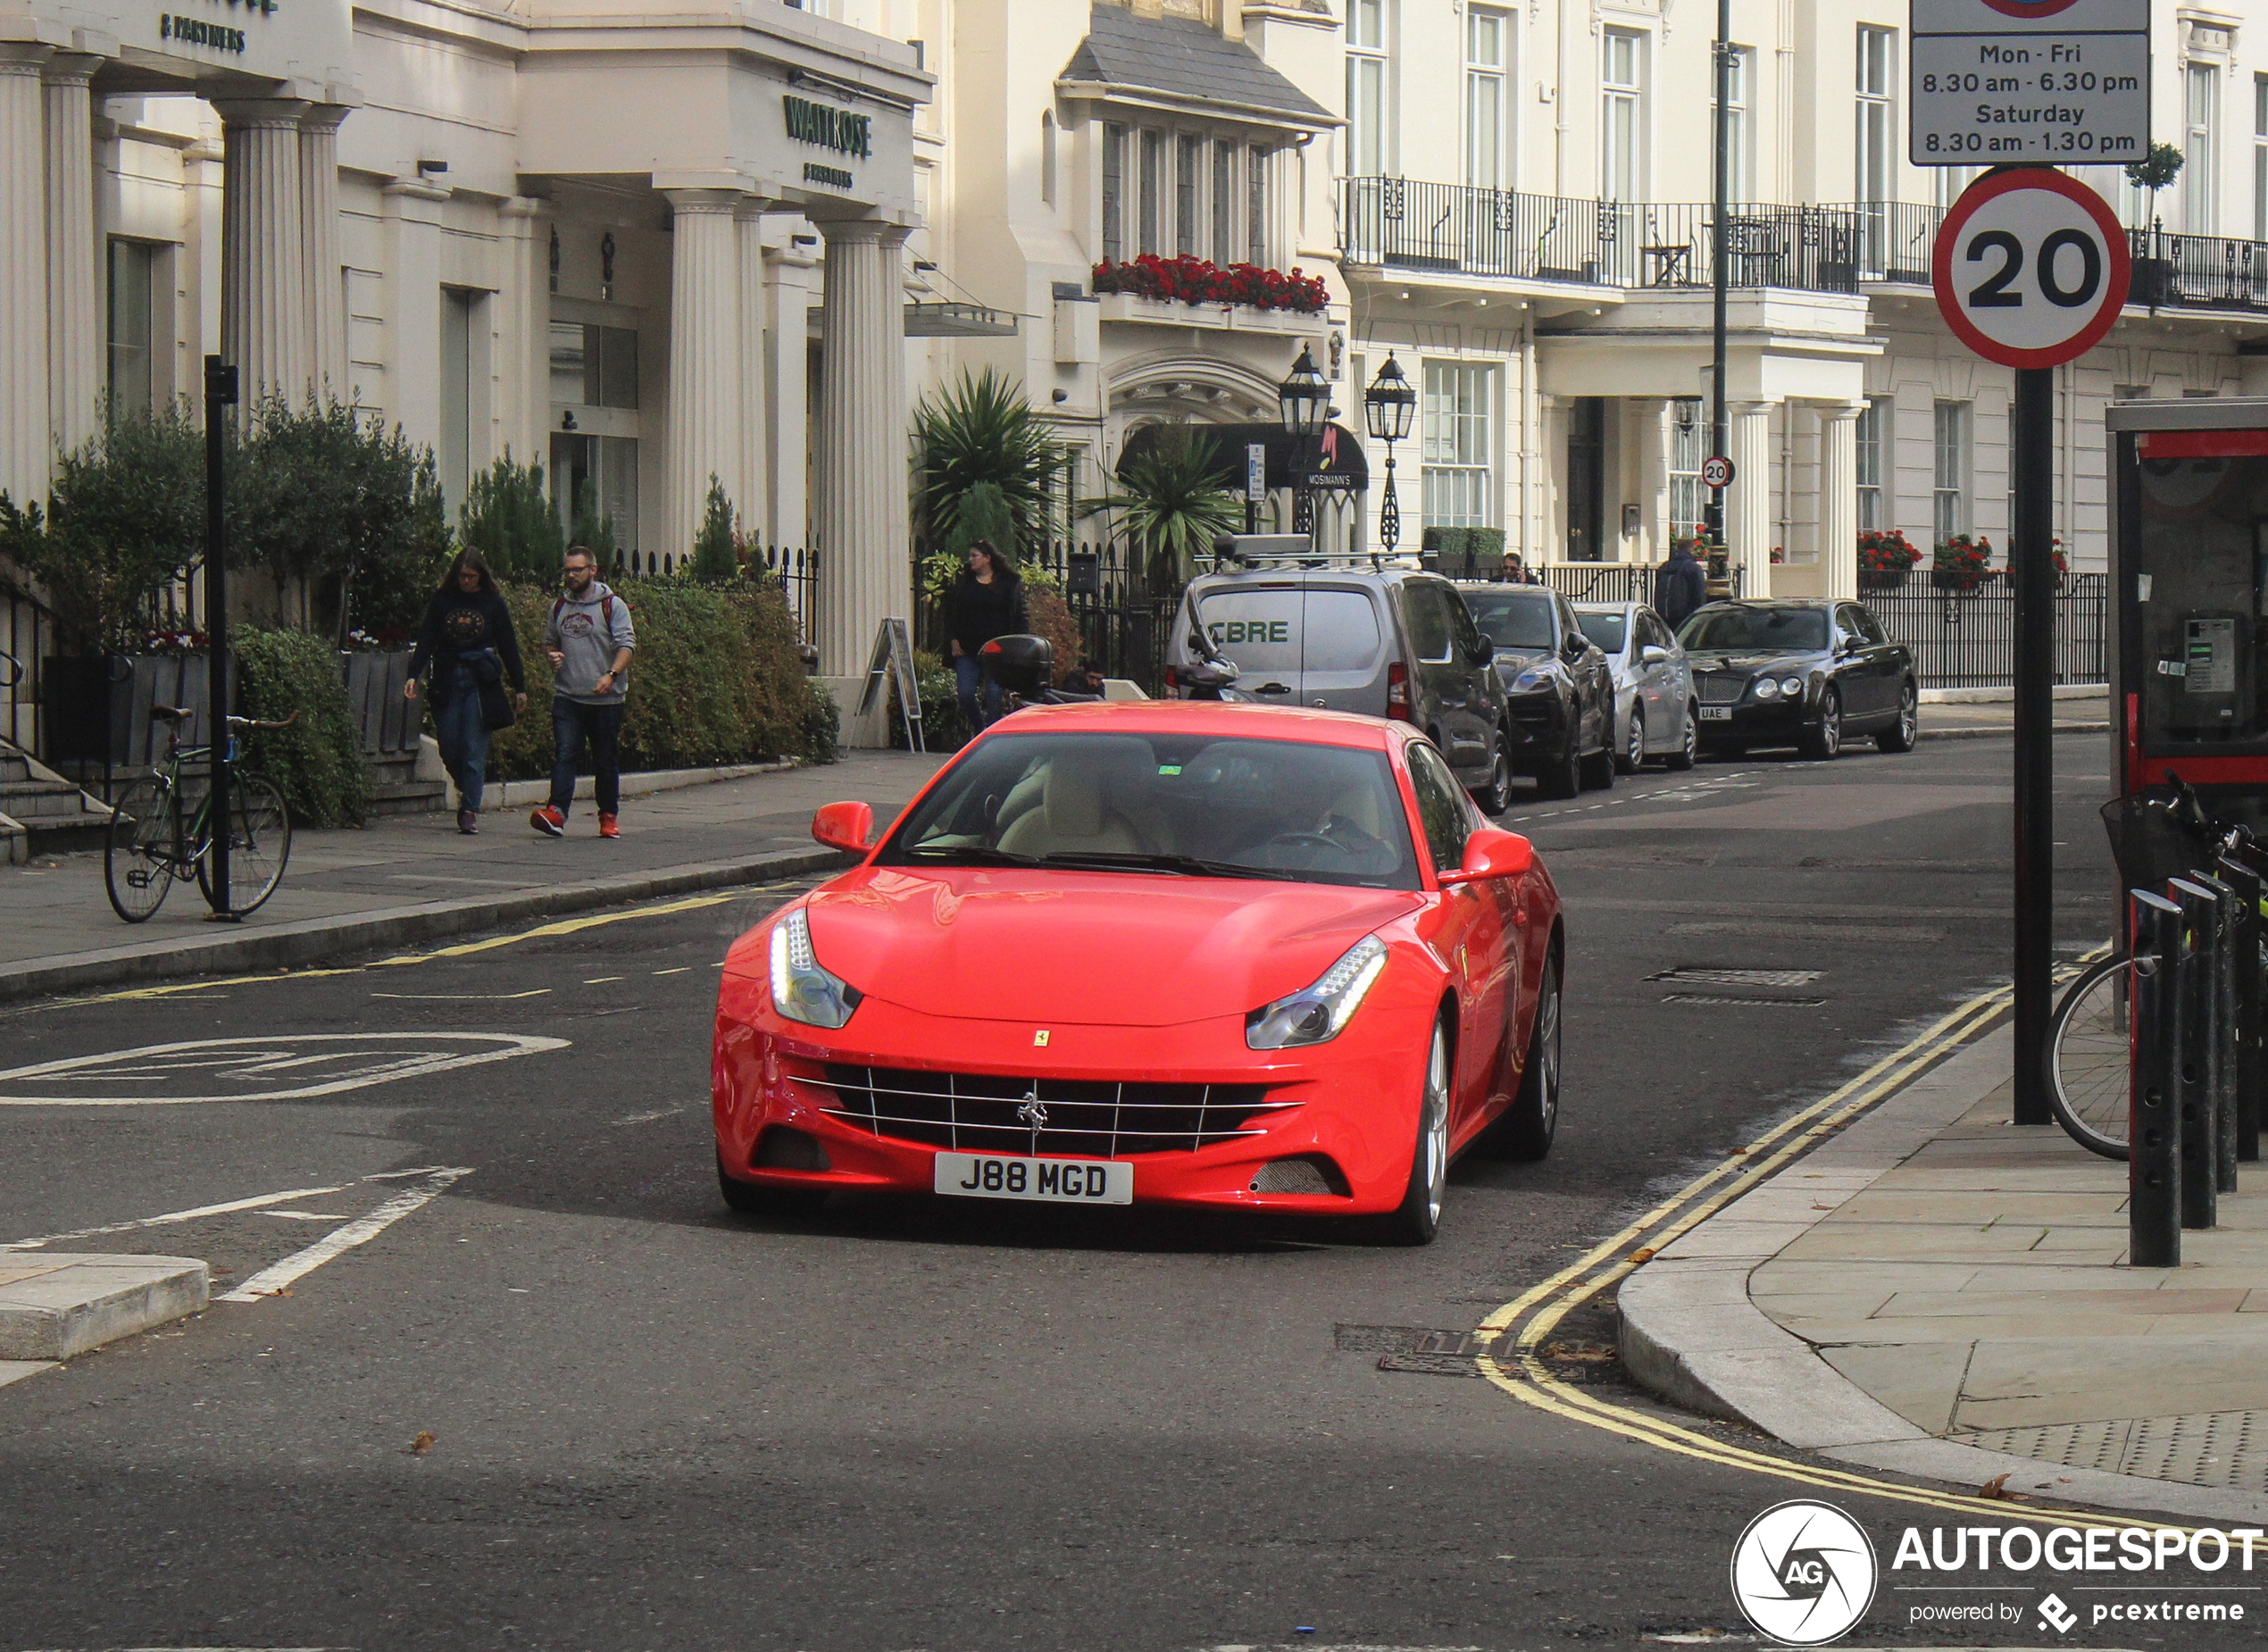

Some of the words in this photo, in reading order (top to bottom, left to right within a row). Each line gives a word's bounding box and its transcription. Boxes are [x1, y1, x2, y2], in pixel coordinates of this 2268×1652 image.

[174, 16, 246, 54] PARTNERS
[1980, 45, 2030, 63] Mon
[2051, 44, 2081, 63] Fri
[1922, 73, 1980, 93] 8.30
[1985, 77, 2020, 91] am
[2039, 71, 2097, 91] 6.30
[2103, 75, 2139, 94] pm
[1975, 104, 2085, 126] Saturday
[783, 95, 872, 159] WAITROSE
[1926, 133, 1982, 152] 8.30
[1988, 136, 2022, 151] am
[2043, 131, 2094, 151] 1.30
[2100, 135, 2136, 154] pm
[1966, 229, 2101, 307] 20
[1309, 475, 1351, 485] MOSIMANN'S
[1706, 465, 1725, 479] 20
[1207, 622, 1288, 643] CBRE
[1702, 708, 1722, 719] UAE
[960, 1159, 1027, 1192] J88
[1038, 1163, 1106, 1197] MGD
